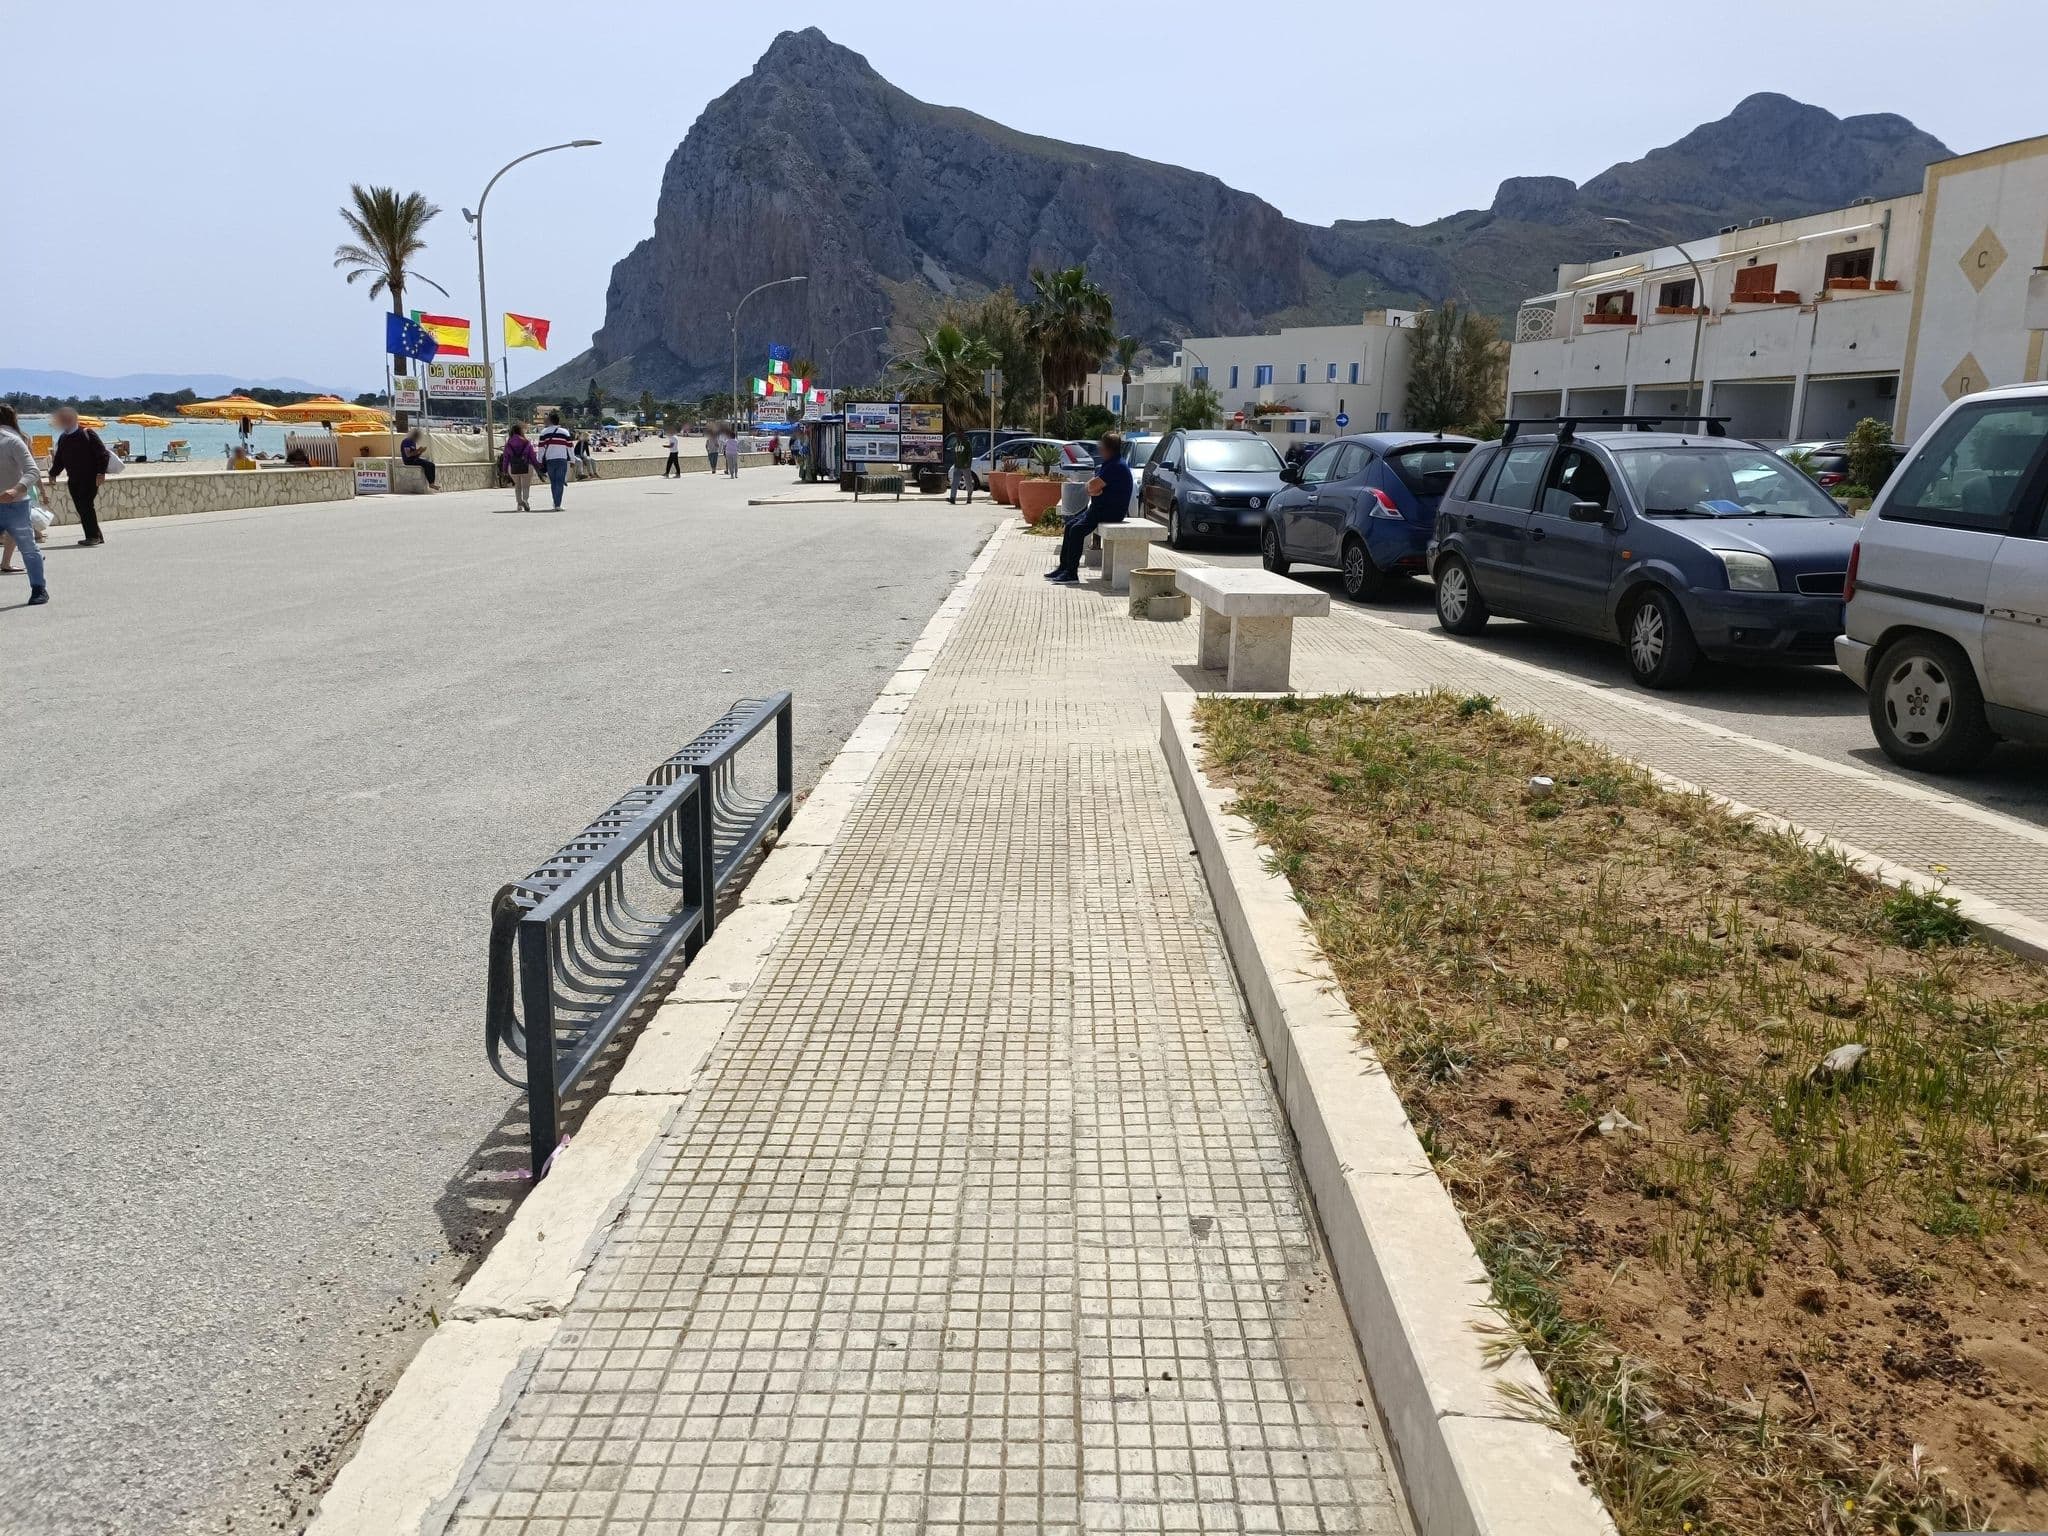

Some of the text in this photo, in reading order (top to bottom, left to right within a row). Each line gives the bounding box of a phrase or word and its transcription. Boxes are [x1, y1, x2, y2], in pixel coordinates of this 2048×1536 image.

[1977, 251, 1988, 268] C
[429, 364, 444, 378] DA
[446, 378, 477, 386] AFFITTA
[1960, 377, 1971, 393] R
